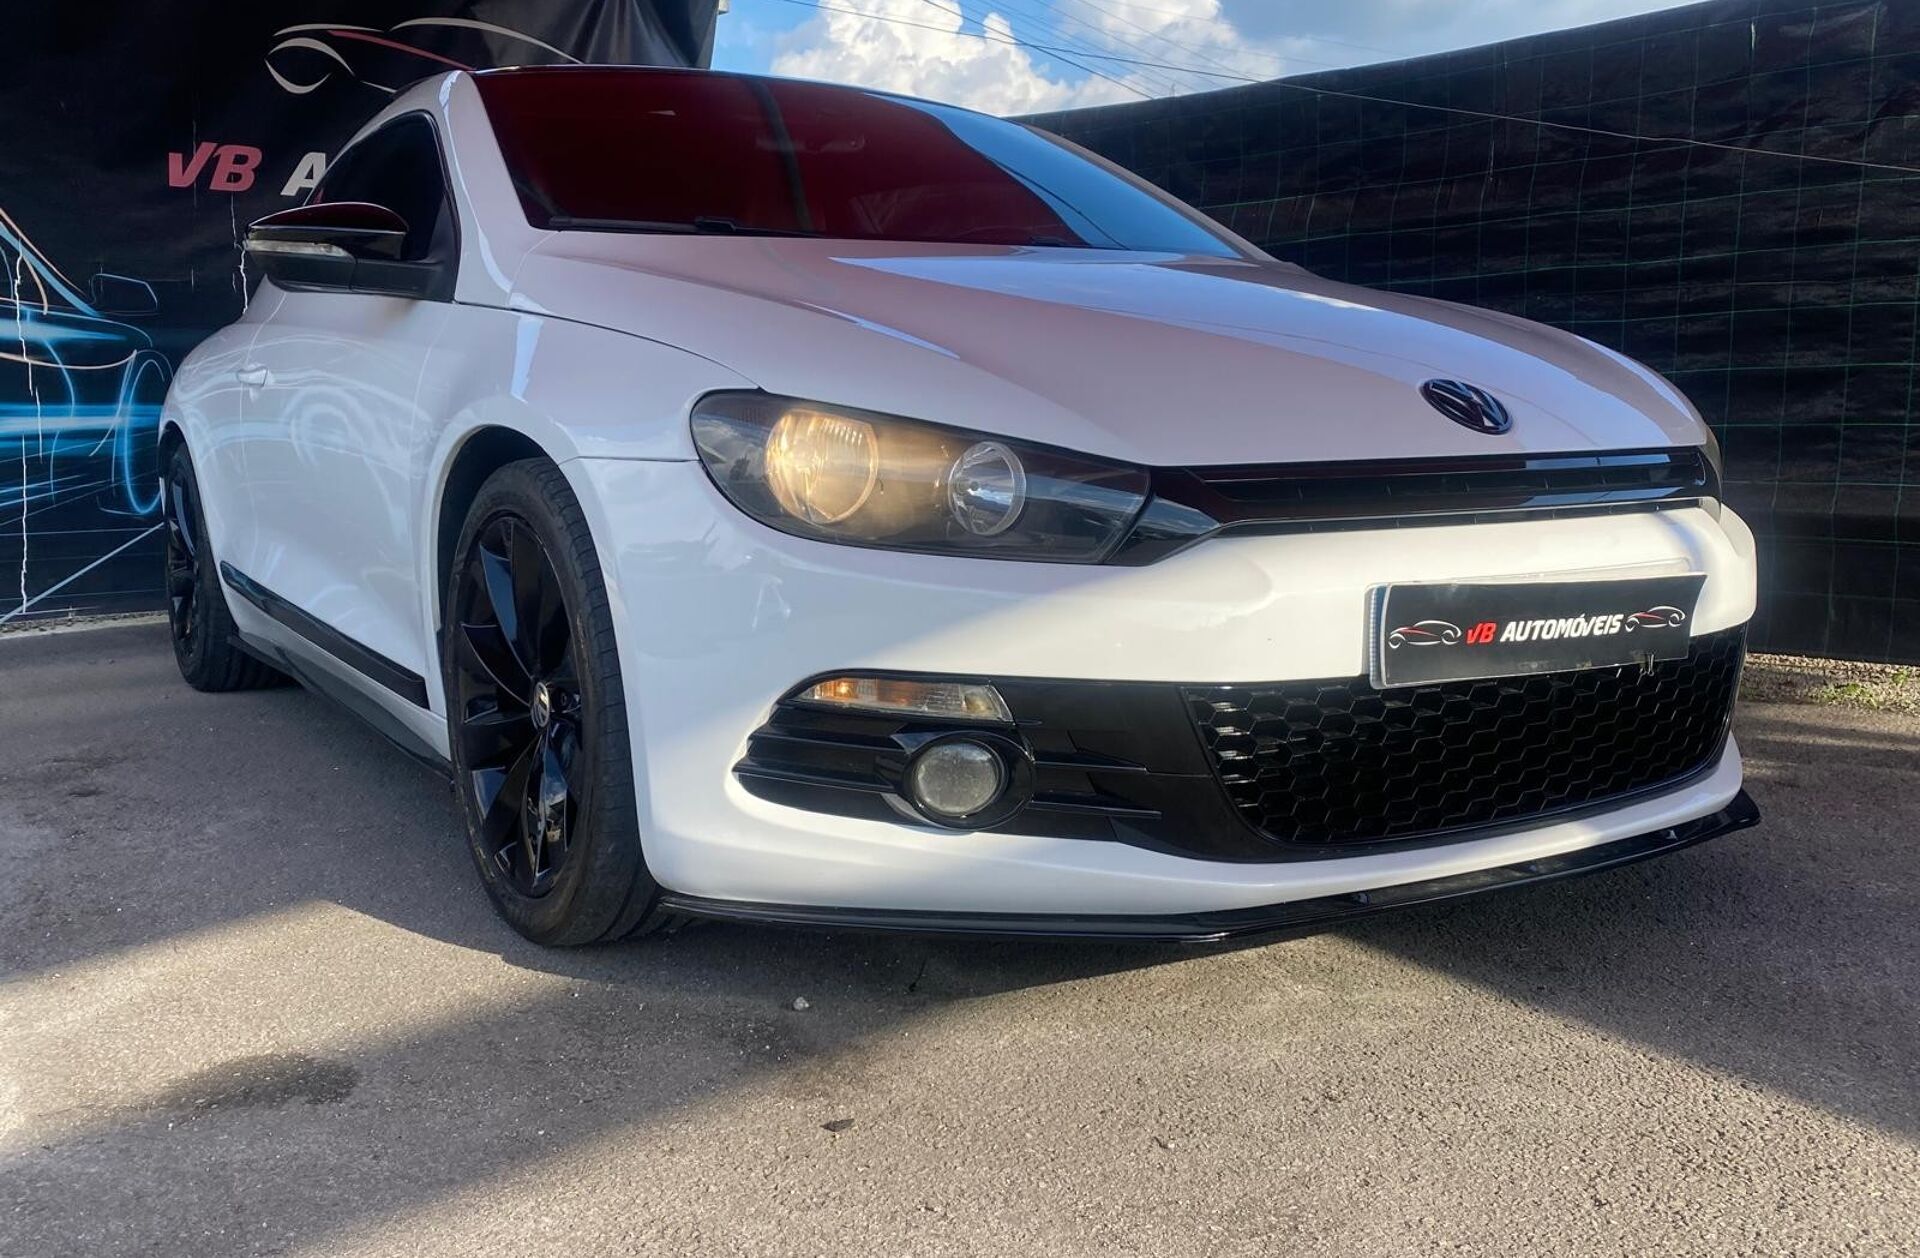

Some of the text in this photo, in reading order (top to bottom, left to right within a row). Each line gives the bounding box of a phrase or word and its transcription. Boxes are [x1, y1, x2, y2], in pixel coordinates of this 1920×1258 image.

[168, 142, 263, 192] VB
[1466, 613, 1624, 644] VB AUTOMÓVEIS
